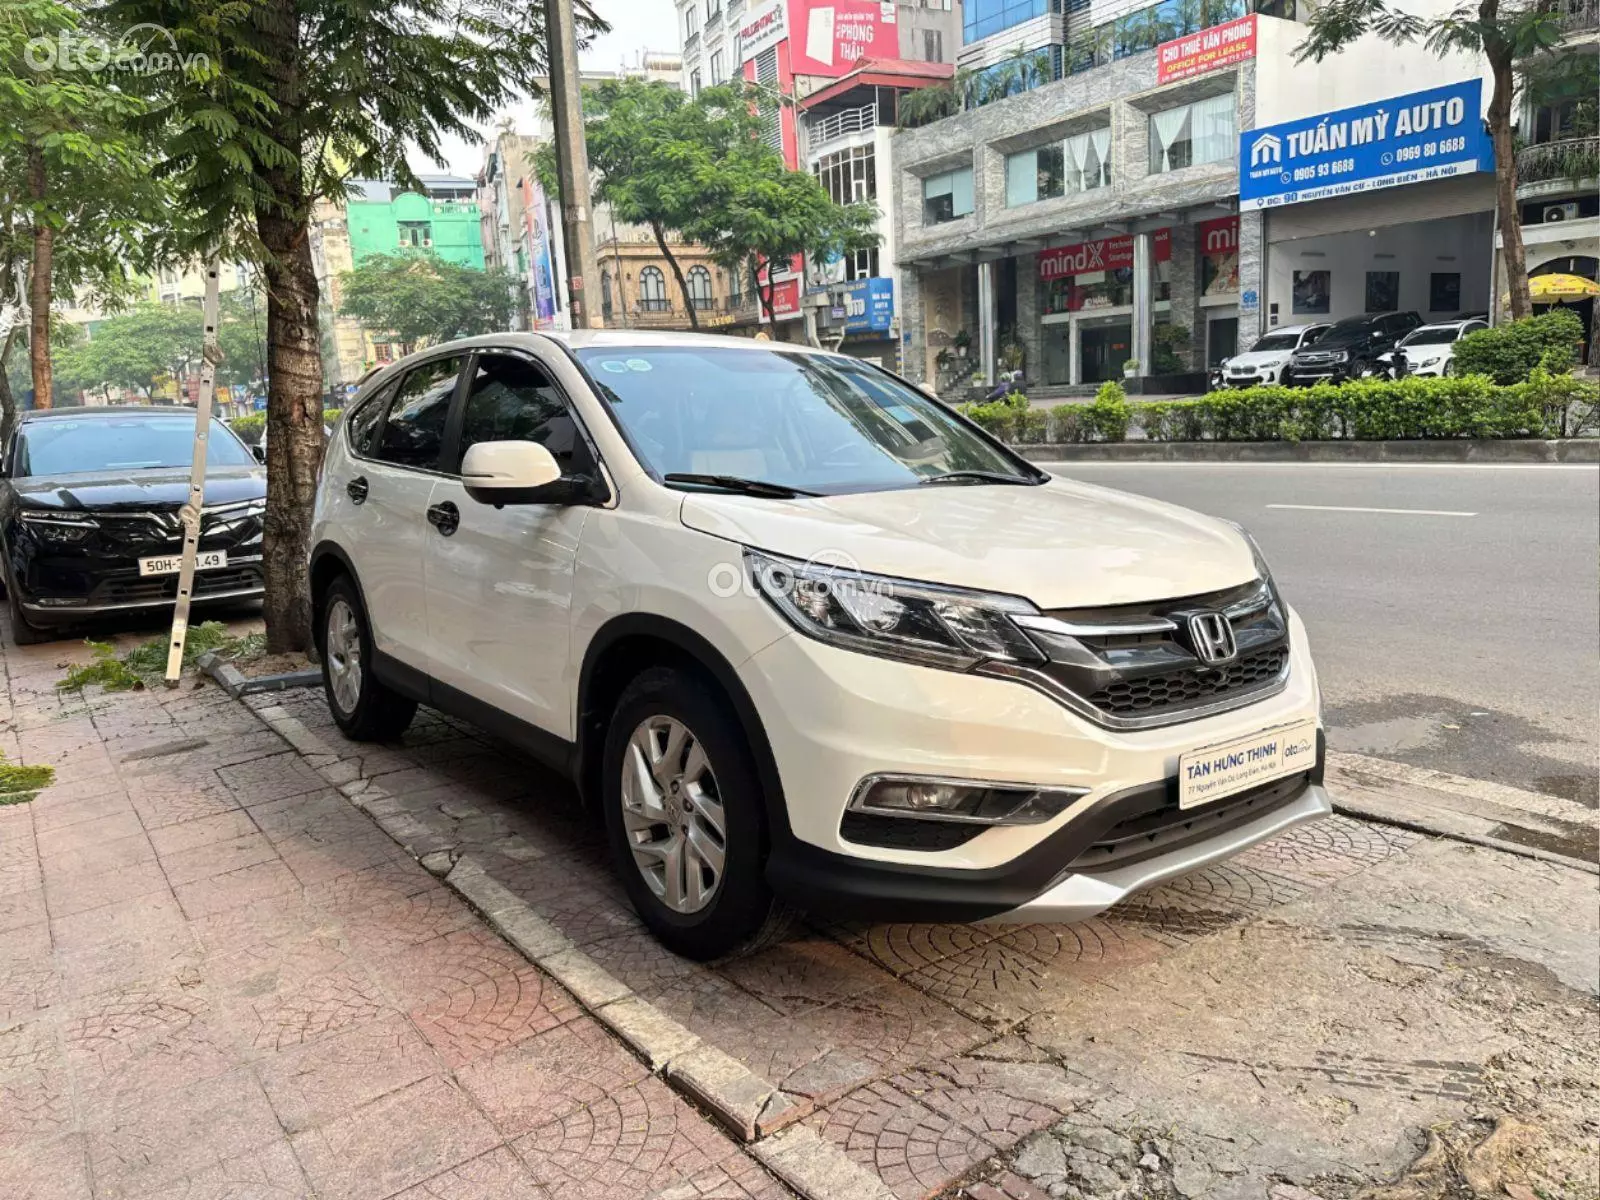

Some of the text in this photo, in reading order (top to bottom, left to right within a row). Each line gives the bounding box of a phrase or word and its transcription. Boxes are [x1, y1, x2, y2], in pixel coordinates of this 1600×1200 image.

[1162, 46, 1179, 63] CHO
[1166, 57, 1196, 73] OFFICE
[1198, 51, 1216, 63] FOR
[1218, 41, 1248, 56] LEASE
[1286, 96, 1464, 158] TUẤN MỲ AUTO
[1396, 136, 1465, 162] 0969 80 6688
[1294, 158, 1354, 181] 0905 93 6688
[1284, 191, 1298, 203] 90
[1372, 178, 1395, 187] LONG
[1397, 173, 1418, 183] BIÊN
[1041, 241, 1105, 276] mindX
[1187, 742, 1277, 779] TÂN HƯNG THỊNH
